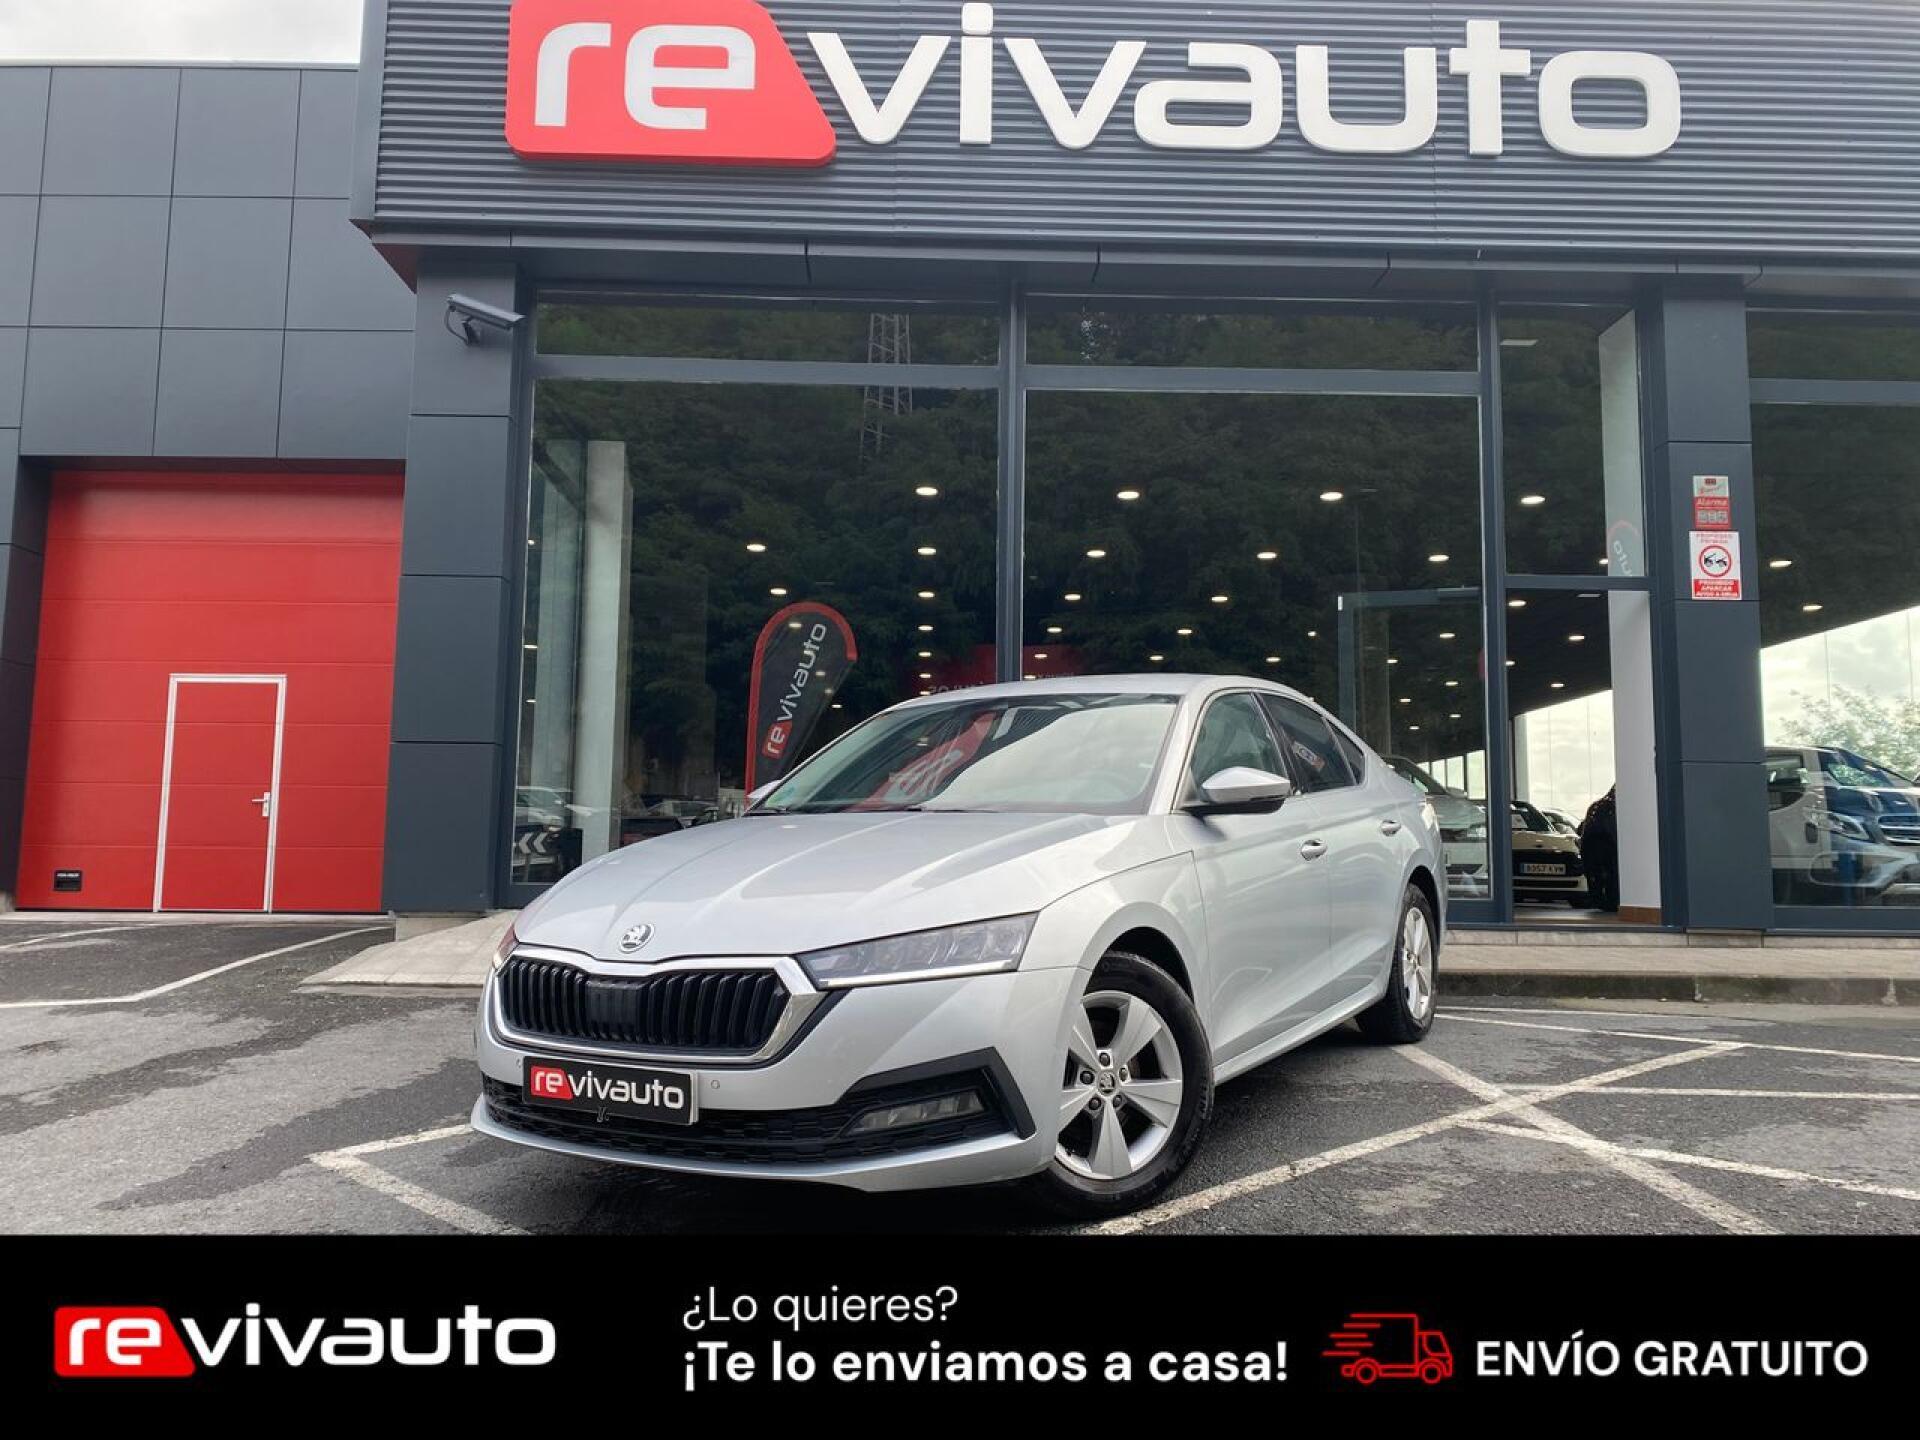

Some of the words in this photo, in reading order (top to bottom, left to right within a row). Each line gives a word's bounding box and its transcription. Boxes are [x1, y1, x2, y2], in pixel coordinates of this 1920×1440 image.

[534, 2, 1682, 157] revivauto
[766, 623, 827, 755] revivauto
[534, 1070, 685, 1110] revivauto
